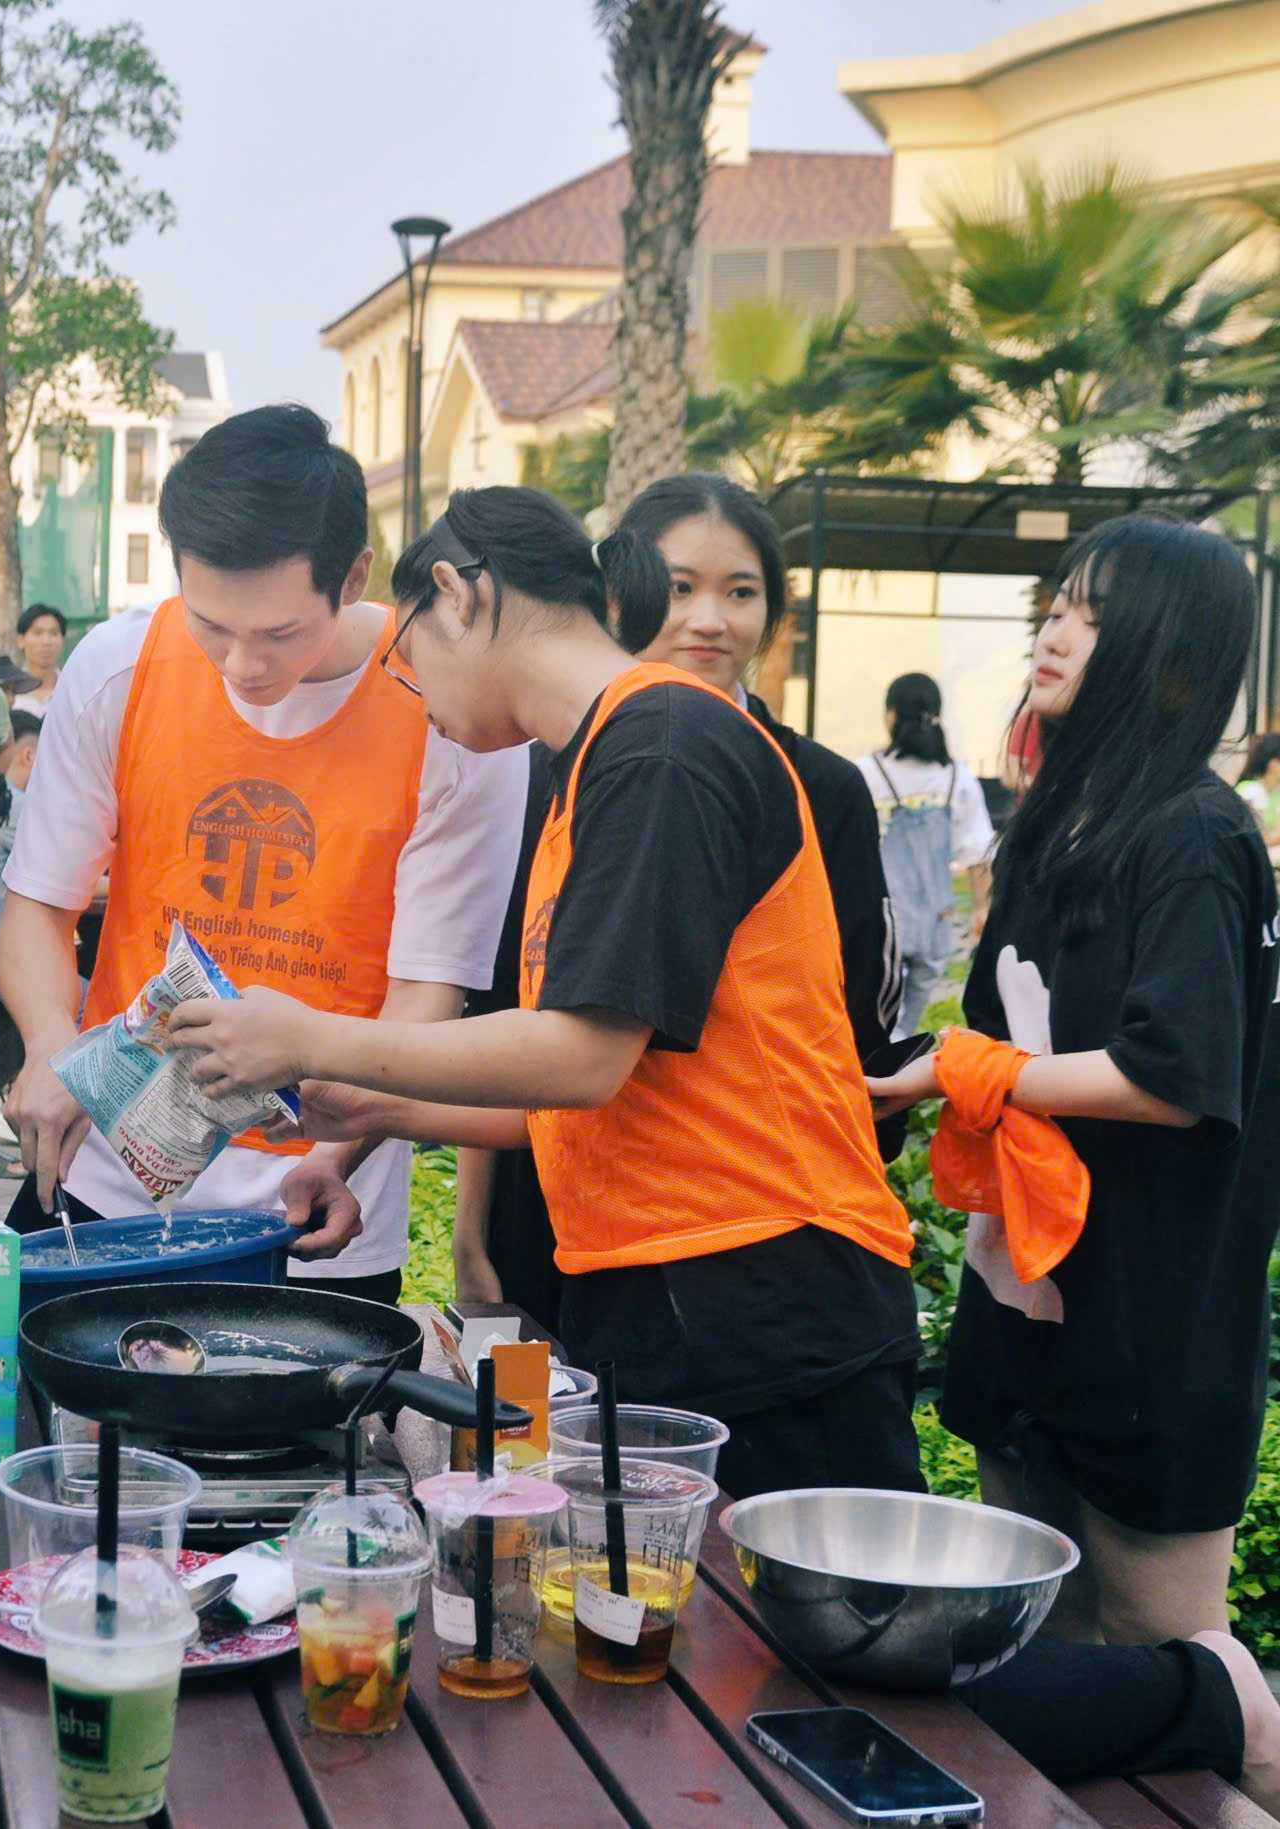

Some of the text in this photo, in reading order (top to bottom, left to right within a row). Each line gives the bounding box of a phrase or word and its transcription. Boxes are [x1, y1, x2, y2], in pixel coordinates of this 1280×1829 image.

[193, 820, 309, 847] ENGLISH HOMESTAY
[184, 910, 242, 936] English
[248, 918, 324, 954] homestay
[266, 951, 288, 974] Anh
[291, 956, 317, 979] giao
[122, 1148, 180, 1194] MEIZAN
